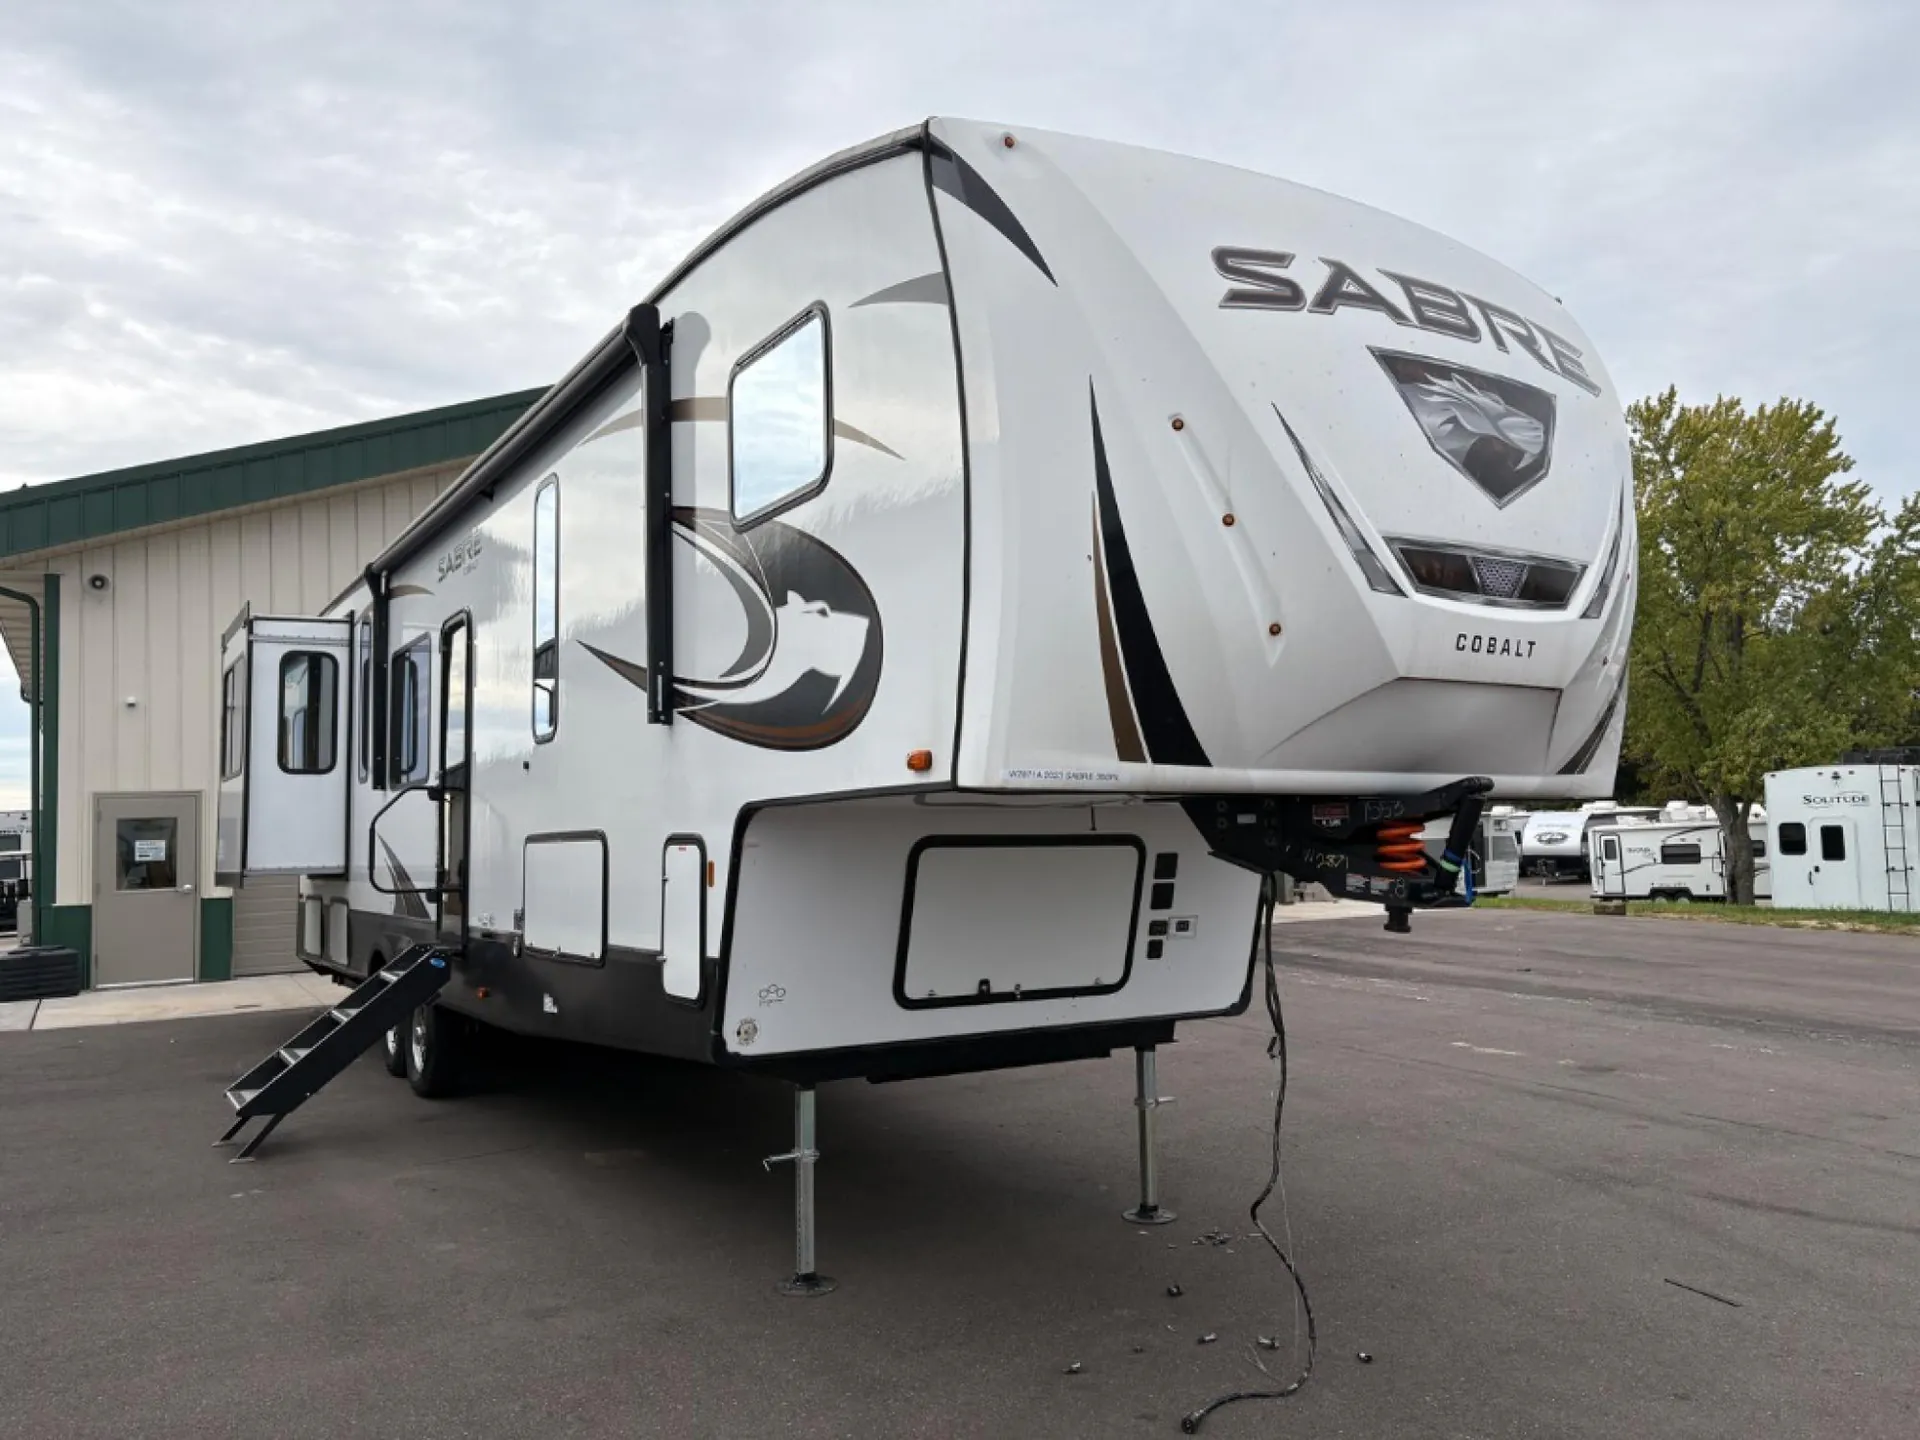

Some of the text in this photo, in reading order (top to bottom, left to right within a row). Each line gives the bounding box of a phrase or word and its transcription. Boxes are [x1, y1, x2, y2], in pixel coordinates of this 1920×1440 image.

[1211, 245, 1600, 398] SABRE
[438, 536, 483, 583] SABRE
[1455, 632, 1537, 660] COBALT
